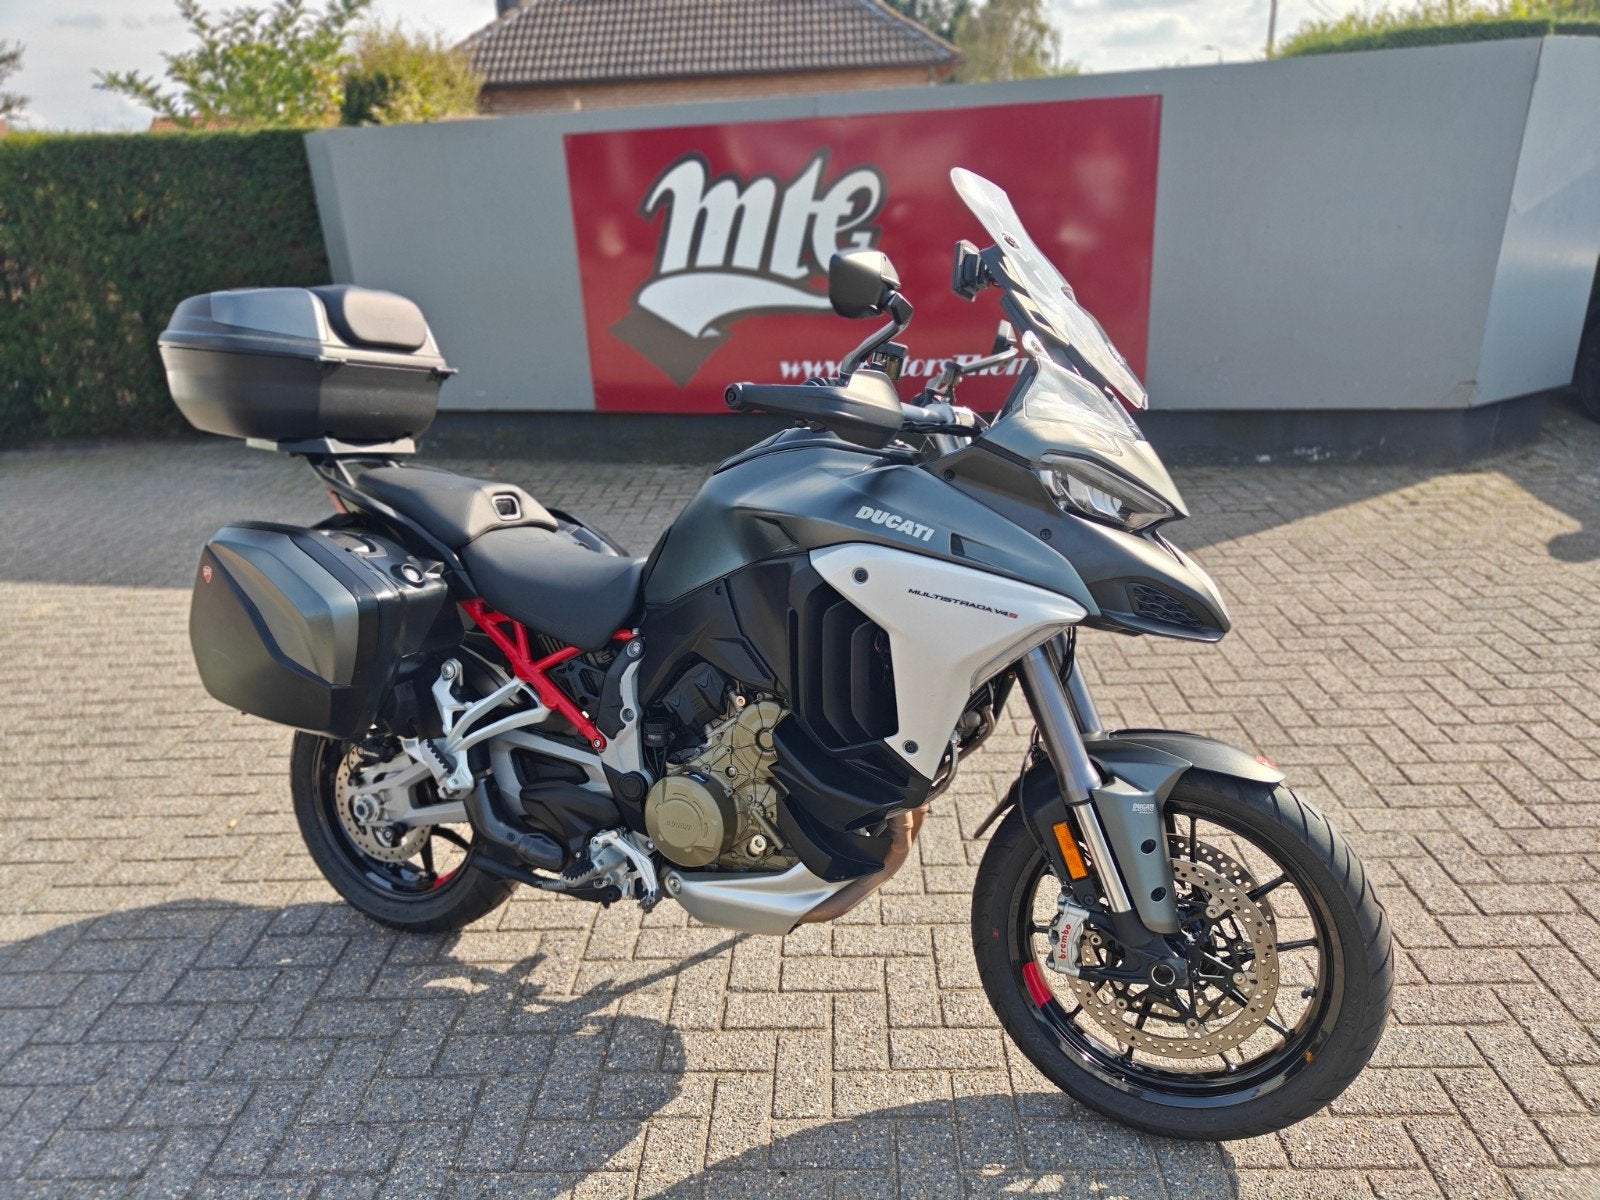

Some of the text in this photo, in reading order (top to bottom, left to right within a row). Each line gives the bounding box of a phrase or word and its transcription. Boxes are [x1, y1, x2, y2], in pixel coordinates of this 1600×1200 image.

[855, 505, 936, 542] DUCATI
[908, 588, 1019, 619] MULTISTRADA V4S
[1058, 924, 1072, 960] brembo
